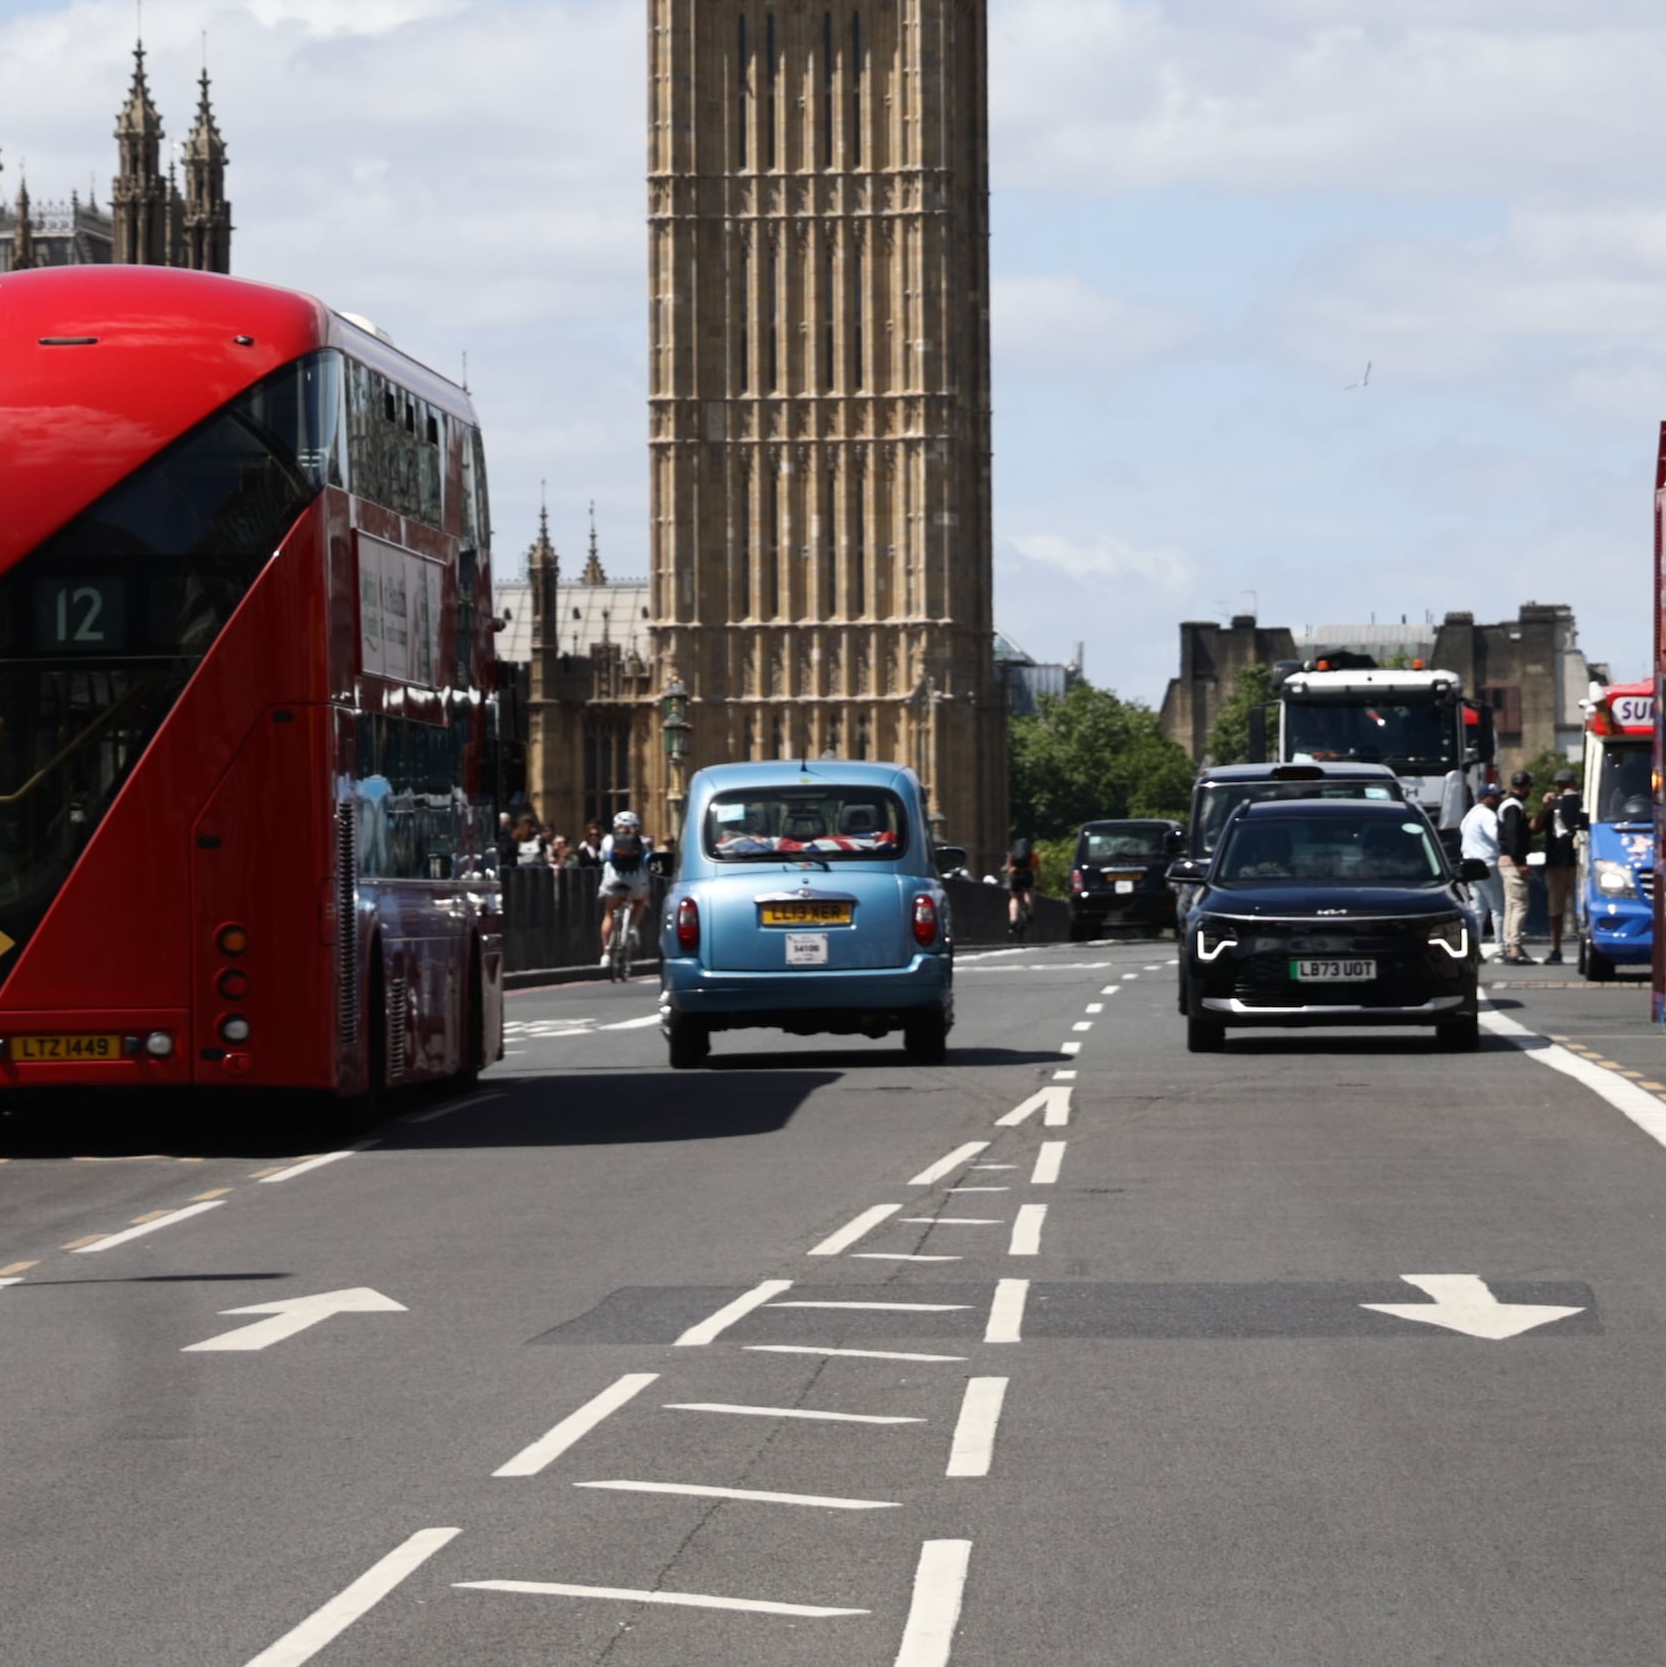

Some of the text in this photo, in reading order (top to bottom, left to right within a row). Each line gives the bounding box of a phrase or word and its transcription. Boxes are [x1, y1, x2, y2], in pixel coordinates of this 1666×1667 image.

[57, 587, 104, 641] 12
[772, 905, 841, 920] LL13 XER
[1300, 961, 1373, 976] LB73 UOT
[23, 1038, 109, 1057] LTZ 1449
